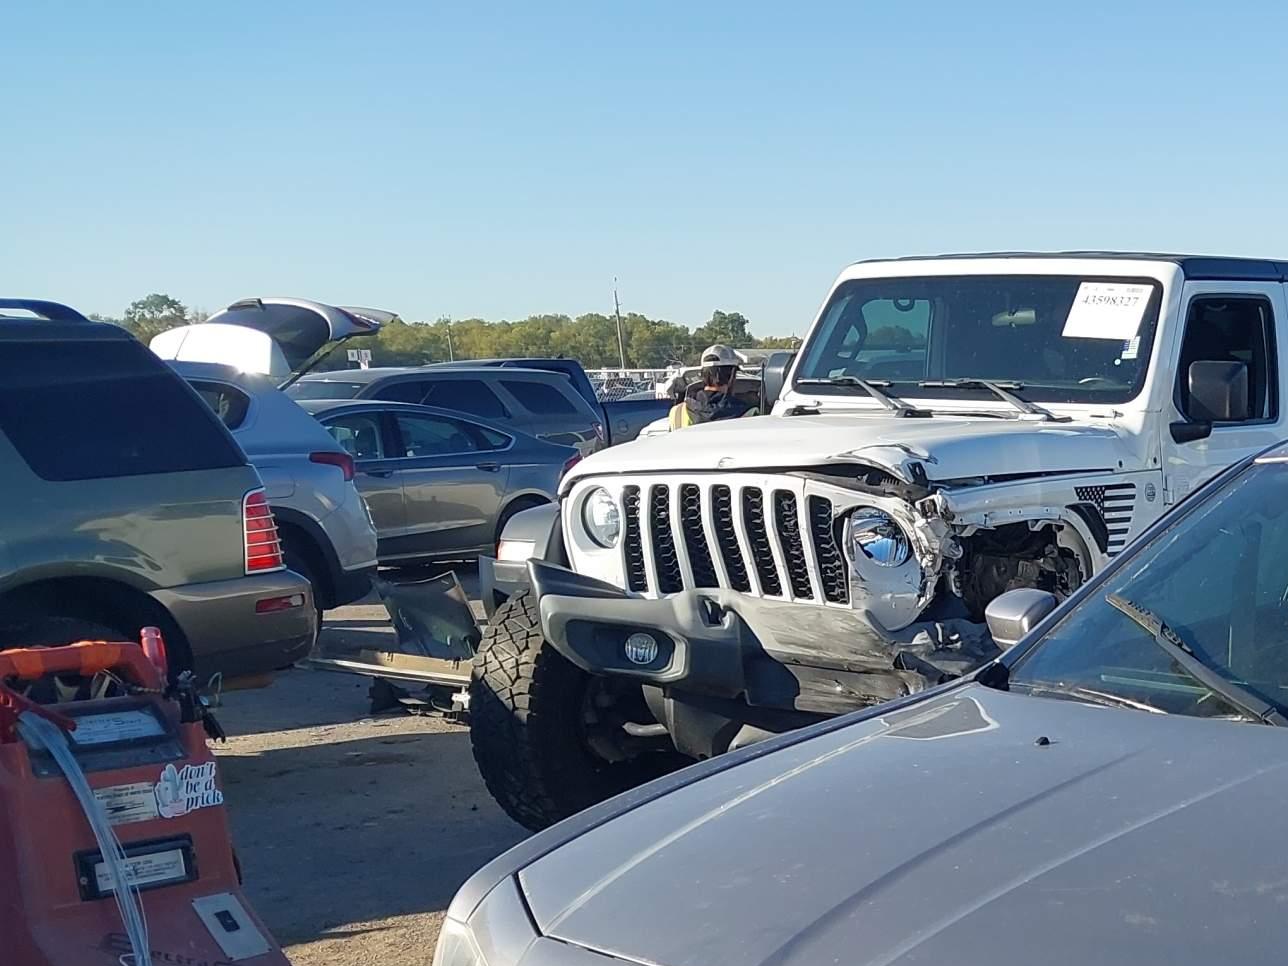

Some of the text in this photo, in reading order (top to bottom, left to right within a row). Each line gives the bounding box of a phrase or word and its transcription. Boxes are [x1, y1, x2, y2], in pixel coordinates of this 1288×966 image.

[1082, 294, 1140, 306] 43598327
[180, 763, 216, 781] don't
[184, 780, 214, 794] be a
[184, 791, 223, 811] prick
